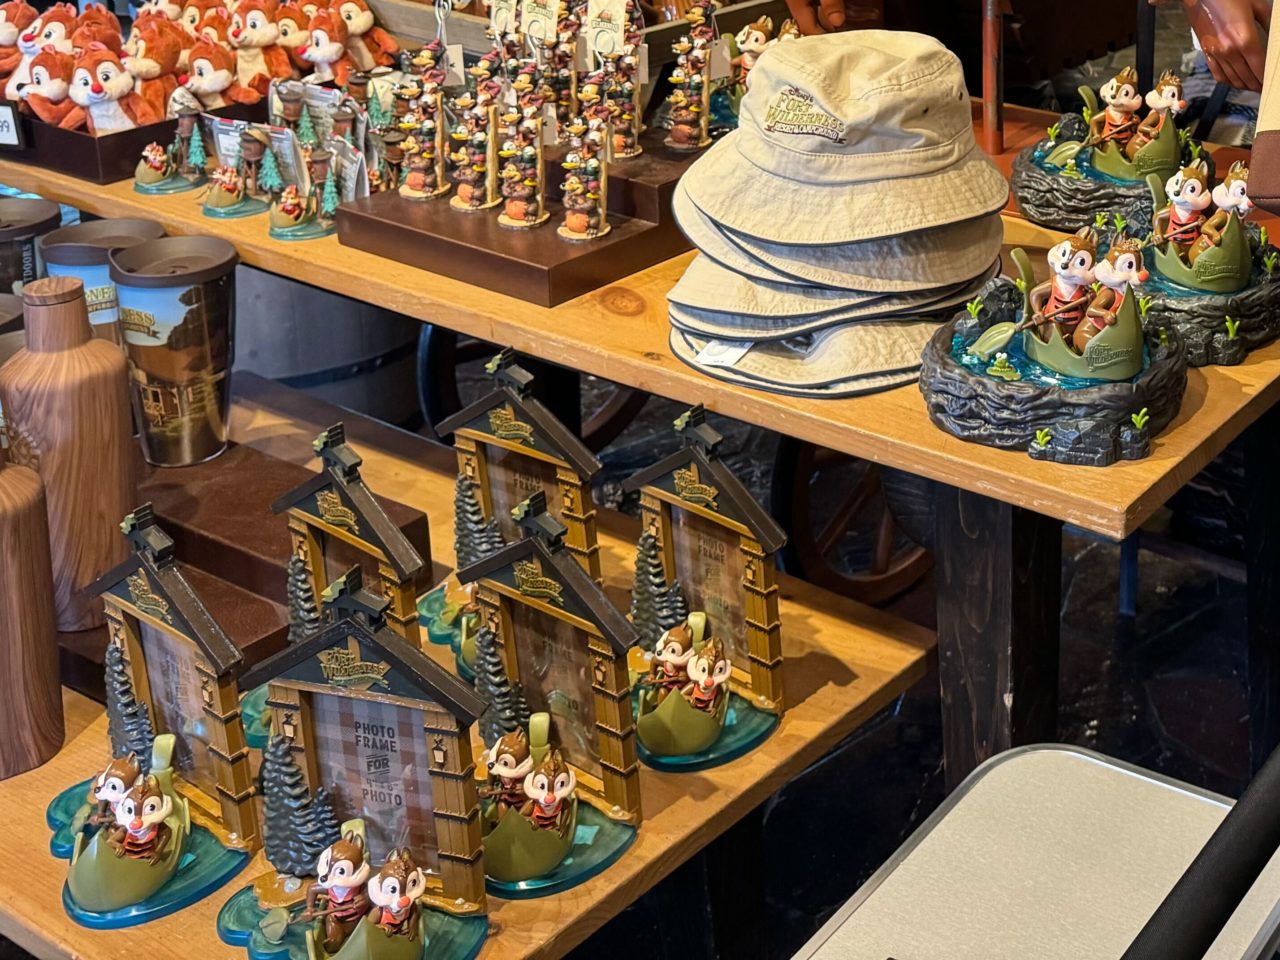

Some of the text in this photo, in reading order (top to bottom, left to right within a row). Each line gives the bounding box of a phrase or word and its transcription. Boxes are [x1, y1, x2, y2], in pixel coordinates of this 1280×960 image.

[776, 91, 814, 118] FORT
[765, 105, 846, 133] WILDERNESS
[22, 243, 34, 283] TDOORS
[354, 721, 396, 739] PHOTO
[355, 735, 398, 753] FRAME
[366, 757, 390, 772] FOR
[362, 788, 403, 806] PHOTO
